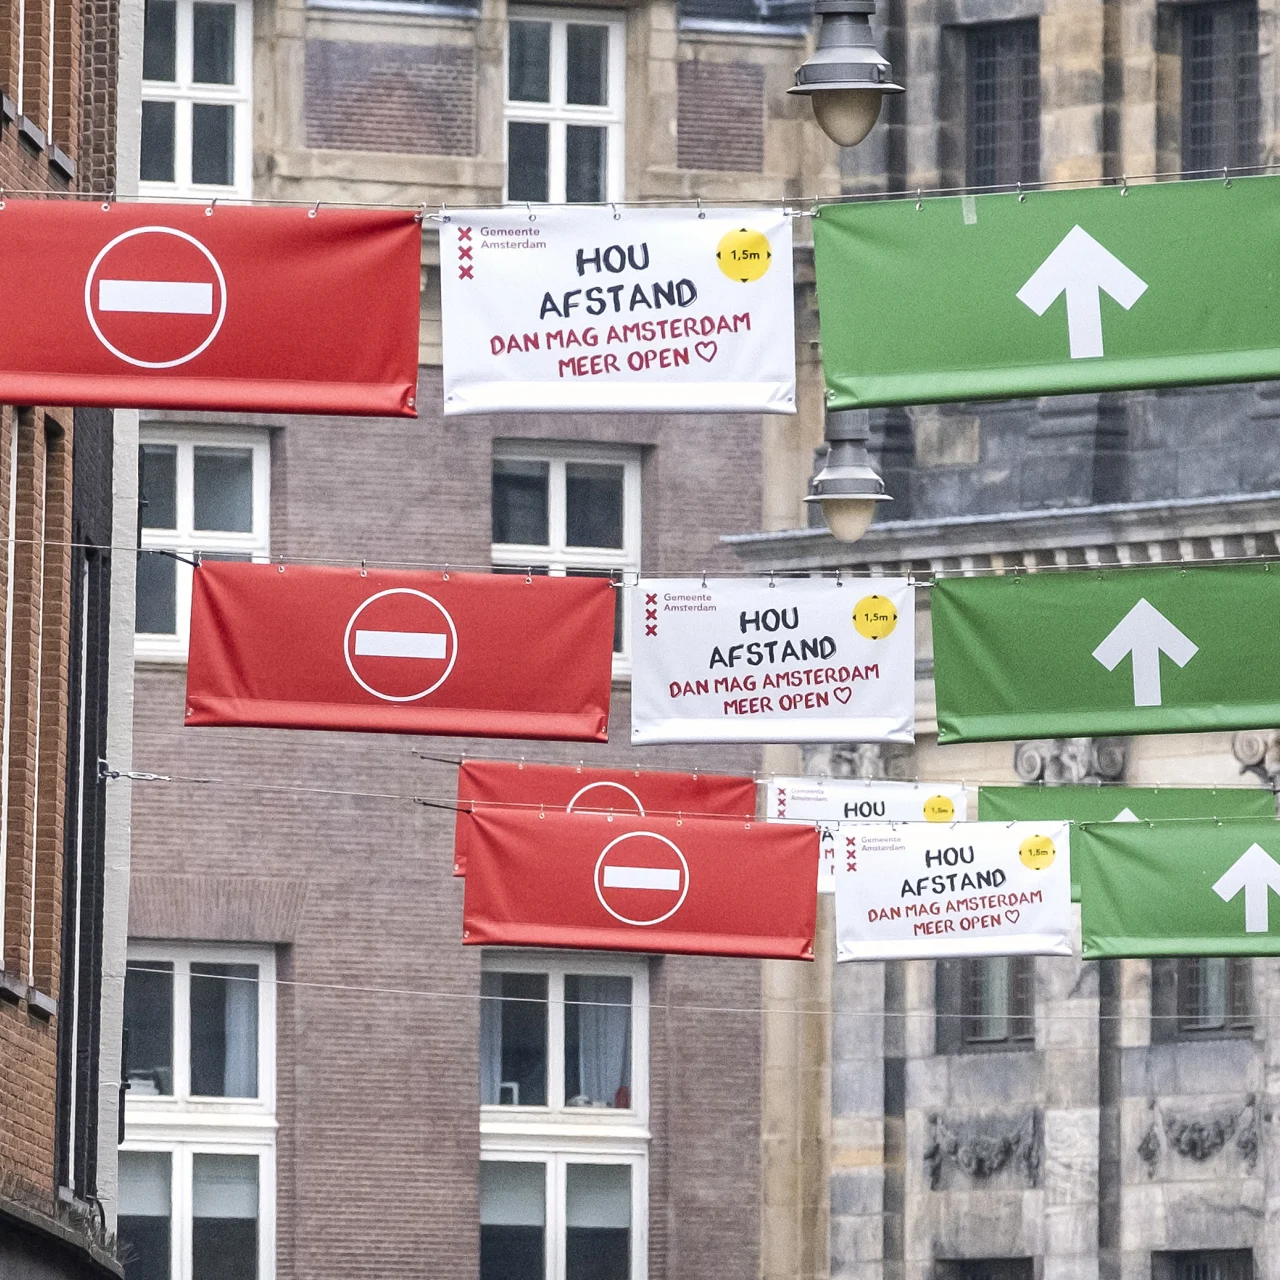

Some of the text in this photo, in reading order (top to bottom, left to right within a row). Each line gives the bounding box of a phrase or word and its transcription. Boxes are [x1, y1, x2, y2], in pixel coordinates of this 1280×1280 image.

[480, 226, 541, 237] Gemeente
[480, 239, 547, 250] Amsterdam
[730, 249, 761, 262] 1,5m
[575, 242, 650, 277] HOU
[539, 278, 698, 320] AFSTAND
[489, 312, 751, 356] DAN MAG AMSTERDAM
[558, 348, 690, 379] MEER OPEN
[663, 592, 712, 602] Gemeente
[663, 603, 717, 612] Amsterdam
[739, 606, 800, 634] HOU
[864, 612, 889, 623] 1,5m
[709, 635, 837, 669] AFSTAND
[669, 663, 880, 699] DAN MAG AMSTERDAM
[723, 691, 829, 716] MEER OPEN
[843, 800, 885, 818] HOU
[860, 844, 906, 852] Amsterdam
[925, 845, 975, 869] HOU
[1028, 848, 1049, 857] 1,5m
[900, 868, 1007, 898] AFSTAND
[867, 890, 1043, 923] DAN MAG AMSTERDAM
[913, 914, 1002, 936] MEER OPEN
